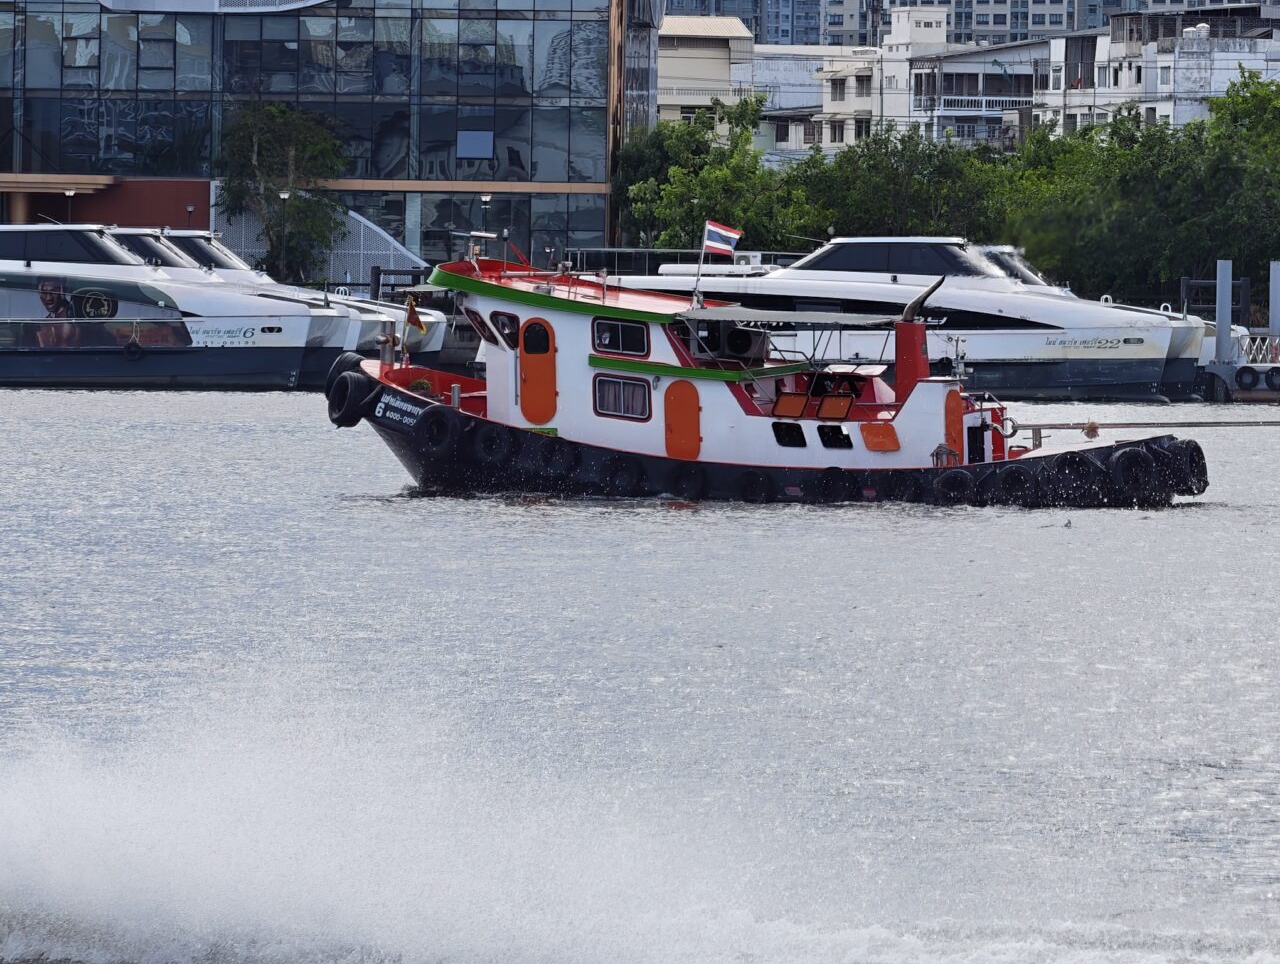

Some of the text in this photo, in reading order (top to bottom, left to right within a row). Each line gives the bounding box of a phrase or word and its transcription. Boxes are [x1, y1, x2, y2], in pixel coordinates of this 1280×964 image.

[242, 327, 256, 339] 6
[1096, 338, 1121, 349] 22
[374, 402, 386, 417] 6
